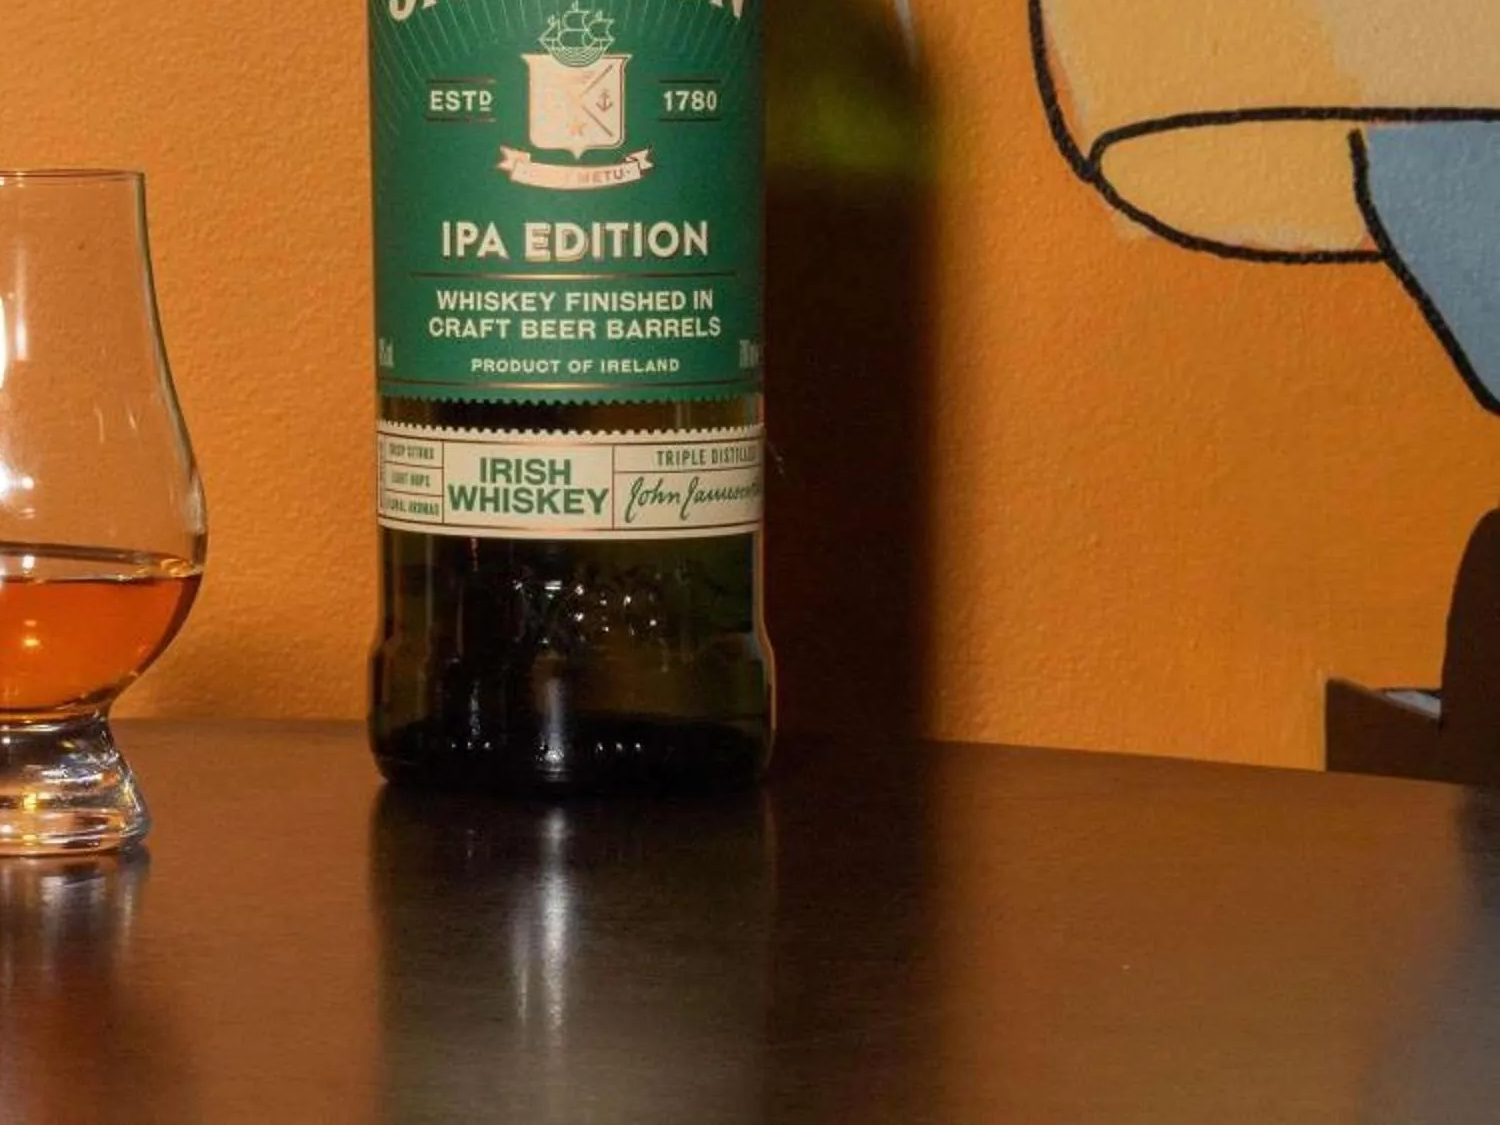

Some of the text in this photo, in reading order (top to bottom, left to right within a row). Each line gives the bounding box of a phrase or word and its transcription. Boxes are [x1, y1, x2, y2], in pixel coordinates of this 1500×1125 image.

[662, 90, 718, 111] 1780
[441, 220, 709, 262] IPA EDITION
[436, 289, 713, 313] WHISKEY FINISHED IN
[428, 316, 722, 340] CRAFT BEER BARRELS
[470, 358, 680, 373] PRODUCT OF IRELAND
[655, 448, 706, 467] TRIPLE
[478, 457, 572, 486] IRISH
[447, 485, 609, 516] WHISKEY
[624, 476, 681, 523] John
